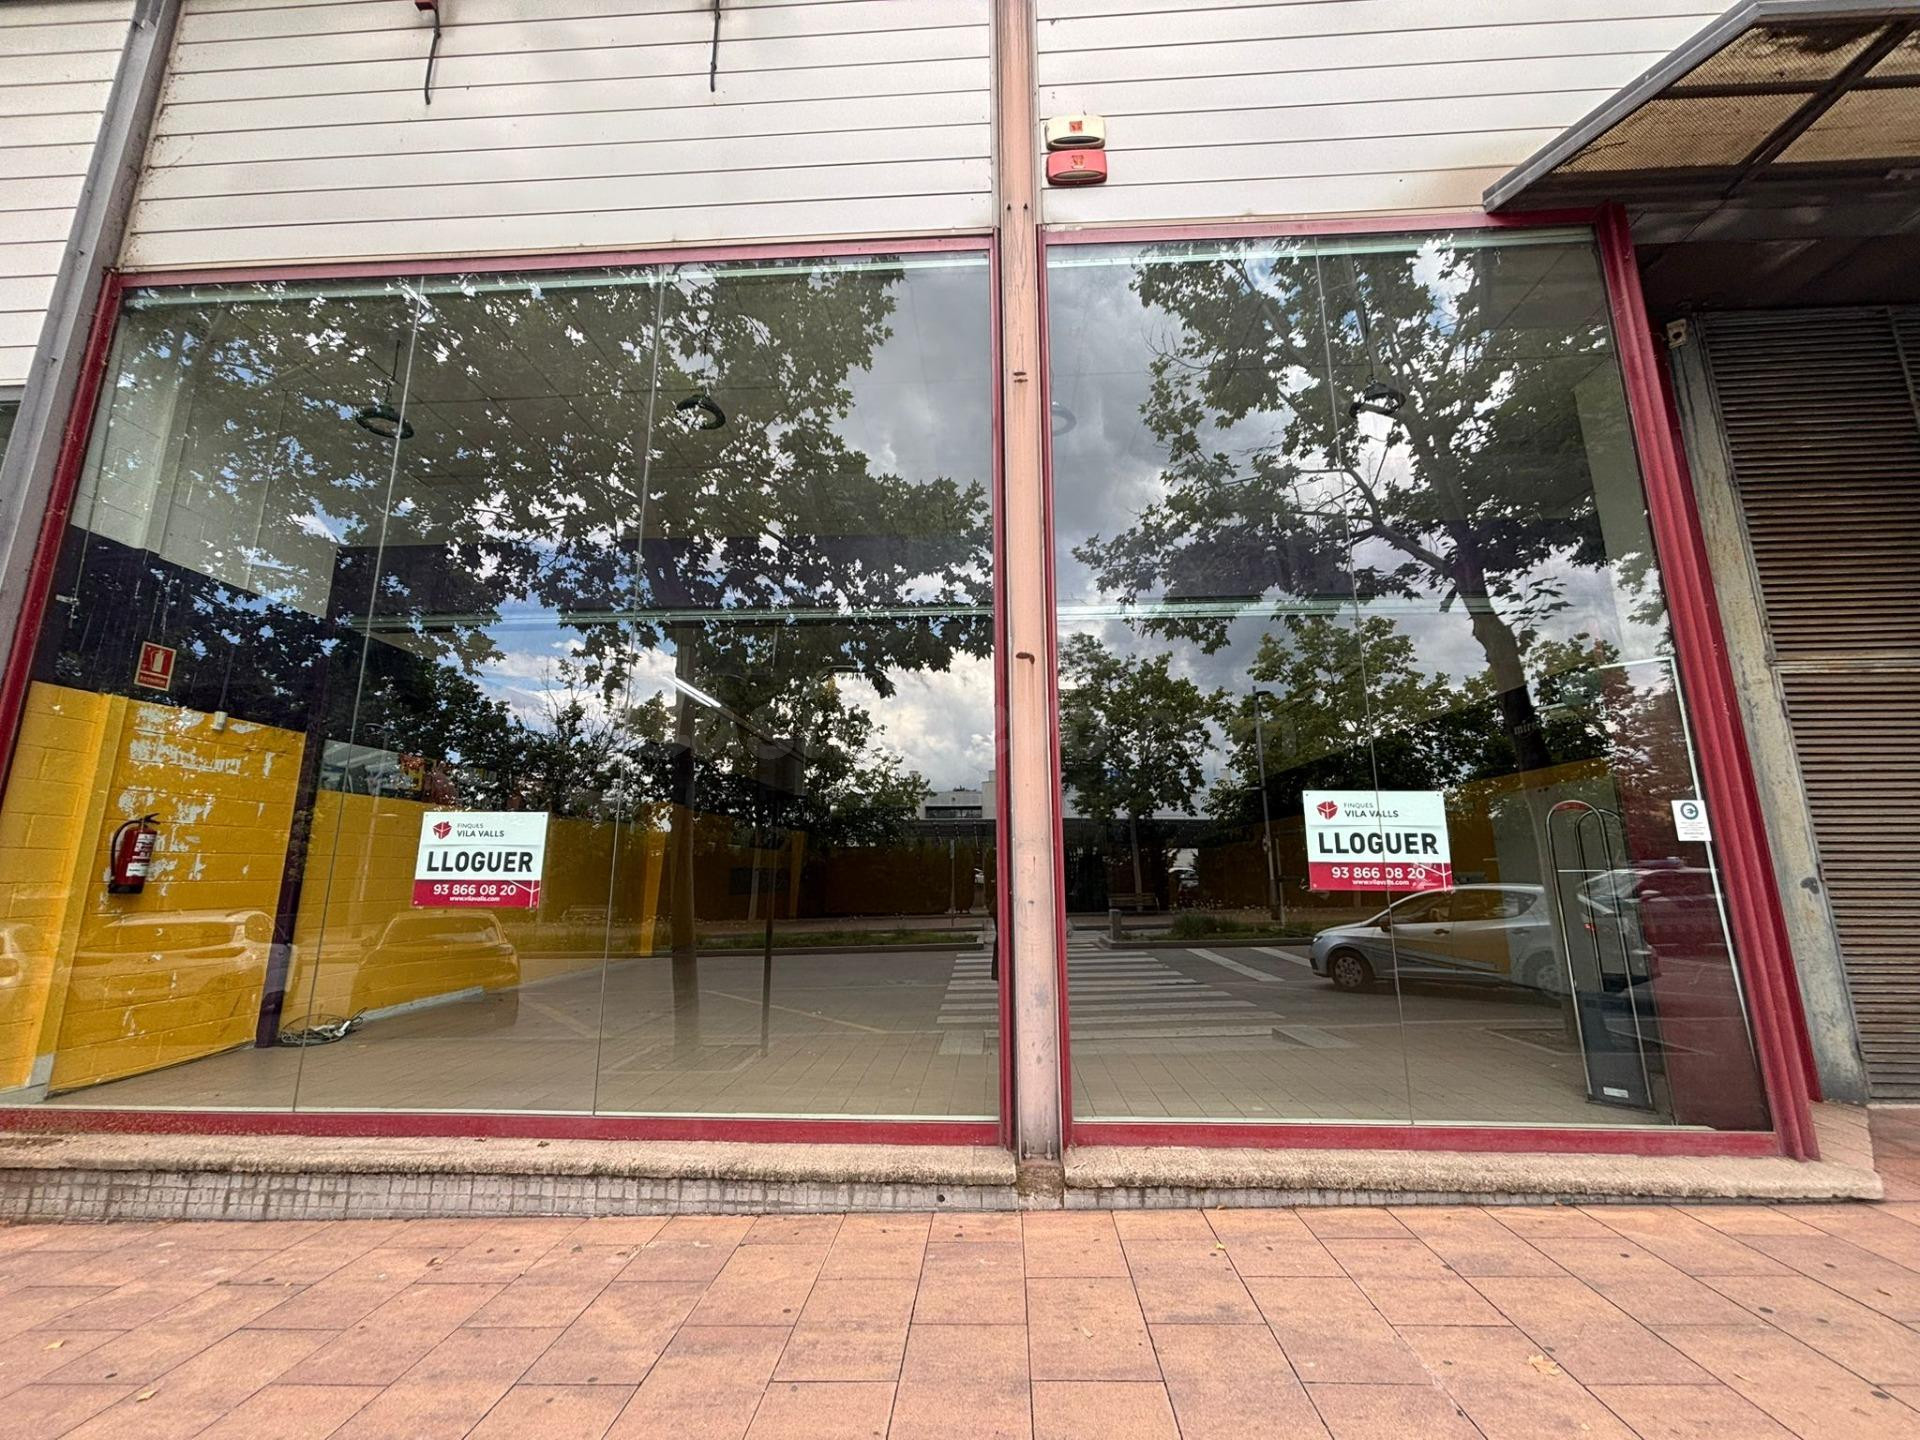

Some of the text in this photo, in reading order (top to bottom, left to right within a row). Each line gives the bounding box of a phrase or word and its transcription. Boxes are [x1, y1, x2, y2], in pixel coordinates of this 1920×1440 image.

[1344, 809, 1399, 818] VILA VALLS
[456, 830, 505, 838] VILA VALLS
[1318, 832, 1439, 855] LLOGUER
[426, 851, 533, 873] LLOGUER
[1331, 866, 1426, 879] 93 866 08 20
[433, 884, 517, 896] 93 866 08 20
